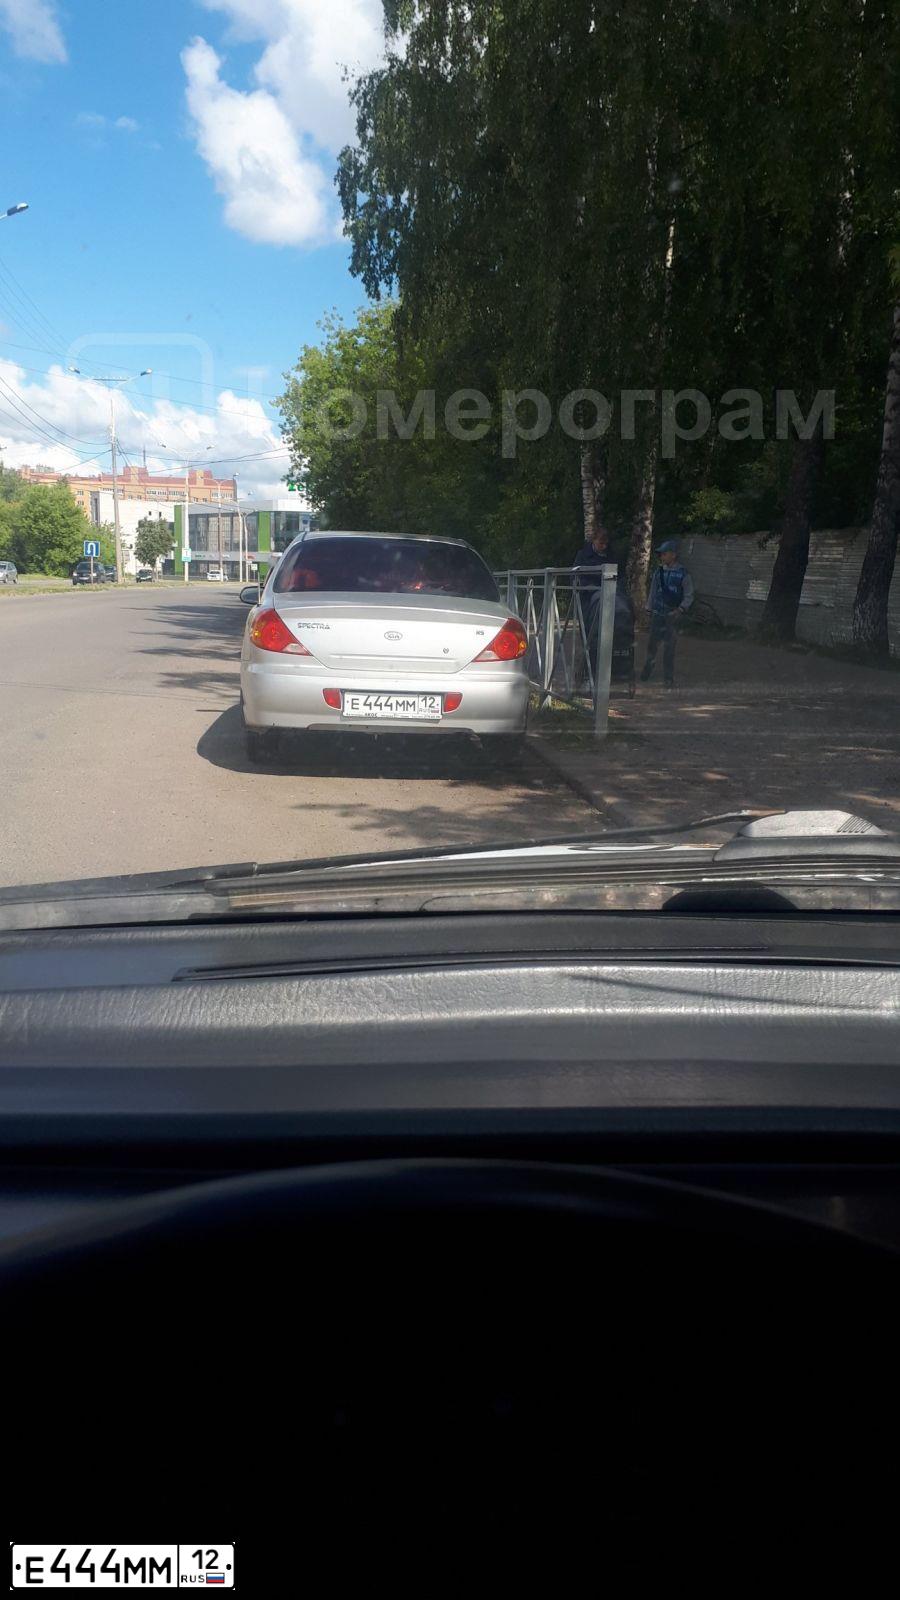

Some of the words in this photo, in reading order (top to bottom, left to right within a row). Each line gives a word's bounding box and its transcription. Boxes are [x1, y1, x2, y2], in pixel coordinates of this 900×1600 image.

[297, 622, 331, 630] SPECTRA
[350, 695, 416, 712] Е444ММ
[420, 695, 436, 708] 12
